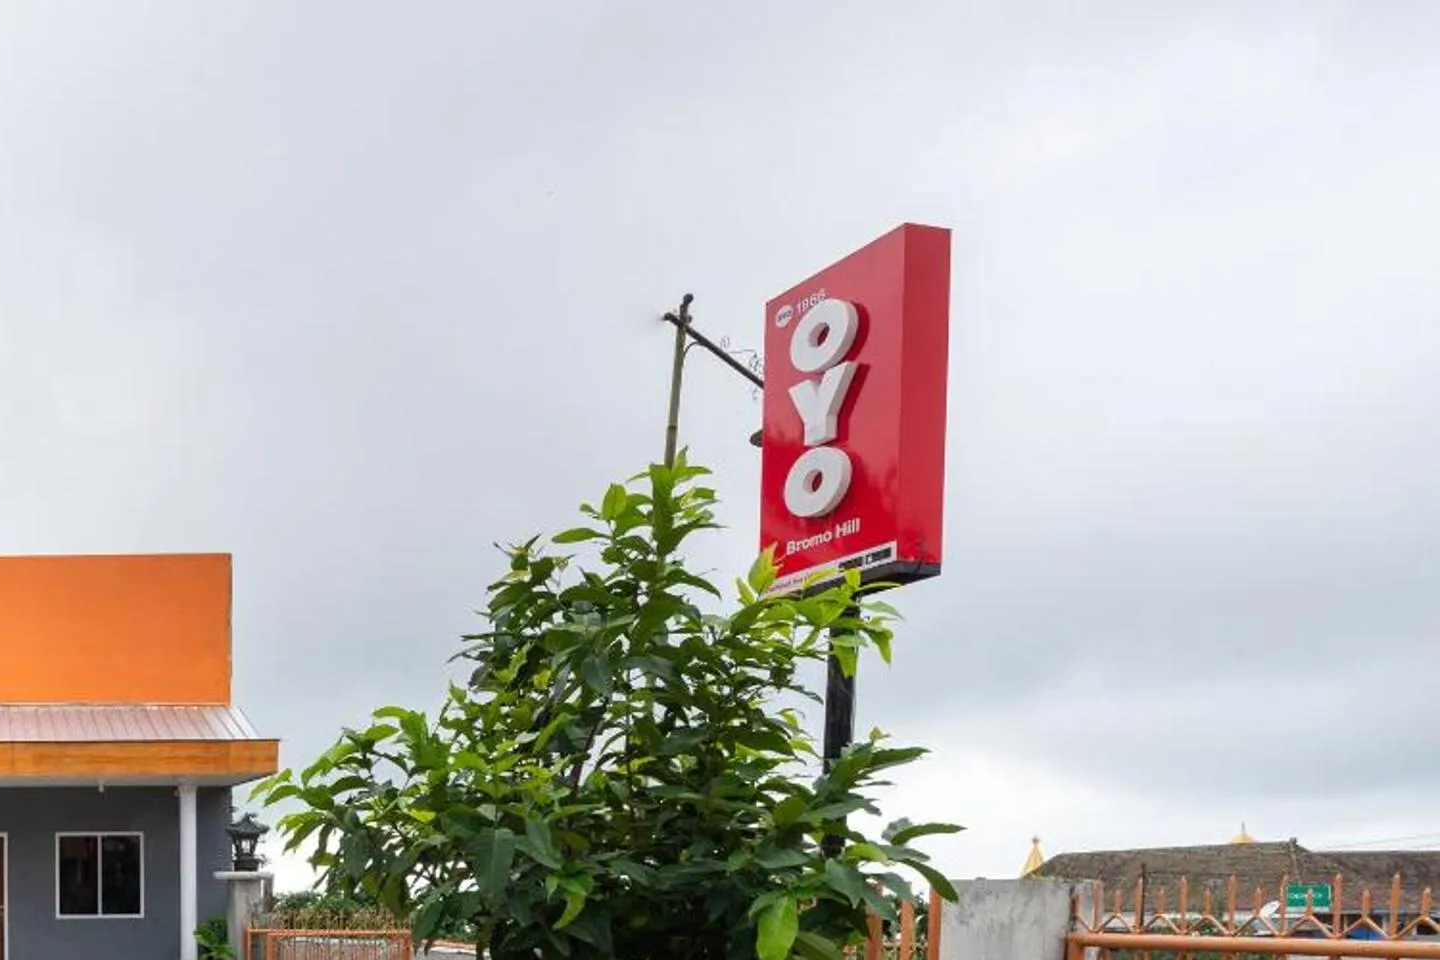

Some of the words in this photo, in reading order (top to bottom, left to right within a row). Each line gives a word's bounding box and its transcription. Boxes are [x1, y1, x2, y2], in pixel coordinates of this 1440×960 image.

[784, 299, 859, 518] OYO
[786, 530, 832, 555] Bromo
[835, 517, 861, 538] Hill
